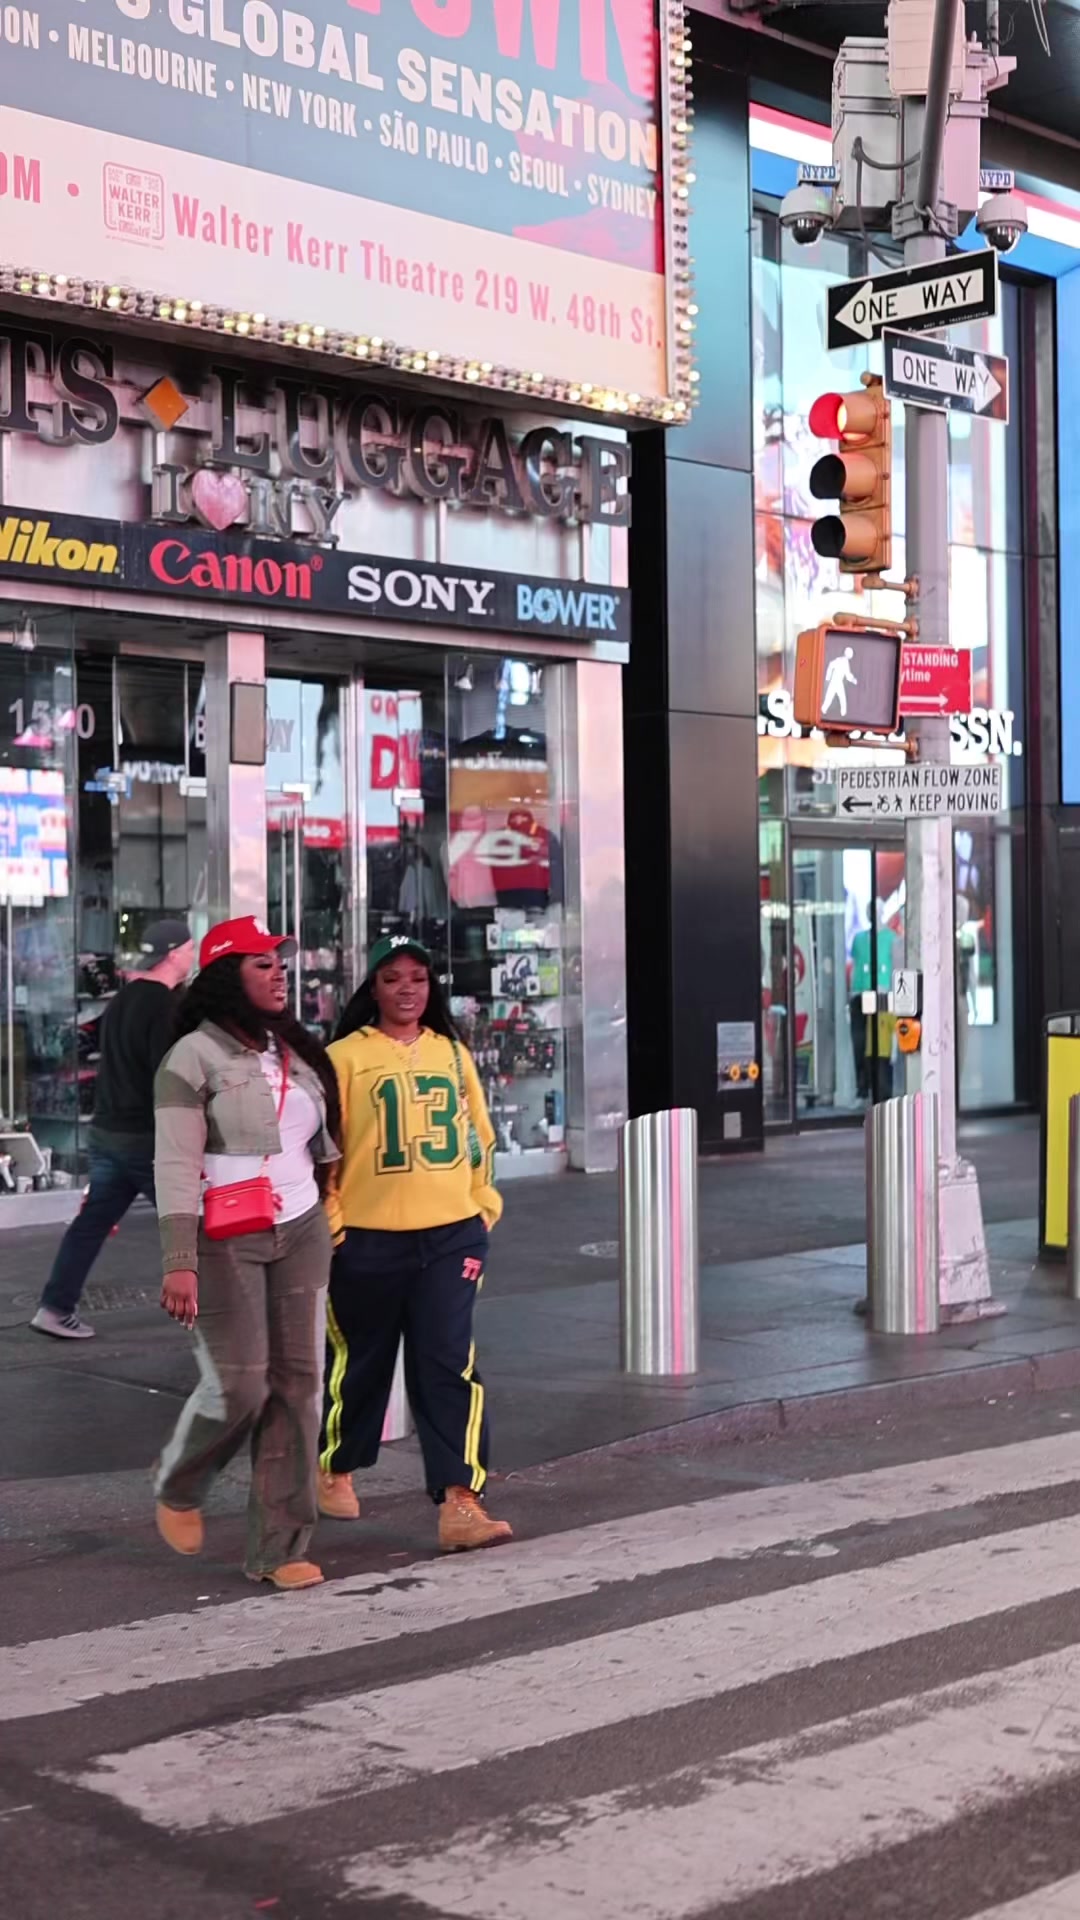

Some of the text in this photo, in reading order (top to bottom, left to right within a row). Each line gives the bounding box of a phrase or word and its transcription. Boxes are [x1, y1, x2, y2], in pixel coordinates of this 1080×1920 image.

[168, 0, 657, 172] GLOBAL SENSATION
[0, 5, 656, 221] ON MELBOURNE NEW YORK SÃO PAULO SEOUL SYDNEY
[802, 165, 836, 179] NYPD
[980, 171, 1011, 186] NYPD
[109, 183, 159, 208] WALTER
[118, 203, 150, 223] KERR
[173, 192, 273, 258] Walter
[287, 221, 348, 275] Kerr
[360, 240, 464, 303] Theatre
[475, 268, 519, 316] 219
[529, 282, 557, 326] W.
[567, 293, 620, 340] 48th
[631, 307, 663, 349] St.
[853, 293, 898, 324] ONE
[922, 276, 972, 309] WAY
[903, 356, 938, 387] ONE
[955, 366, 989, 400] WAY
[207, 362, 632, 528] LUGGAGE
[247, 475, 352, 548] NY
[348, 565, 495, 615] SONY
[517, 584, 620, 630] BOWER
[903, 652, 958, 668] STANDING
[841, 770, 919, 789] PEDESTRIAN
[924, 769, 959, 787] FLOW
[964, 768, 998, 786] ZONE
[910, 792, 998, 811] KEEP MOVING
[371, 1071, 466, 1176] 13
